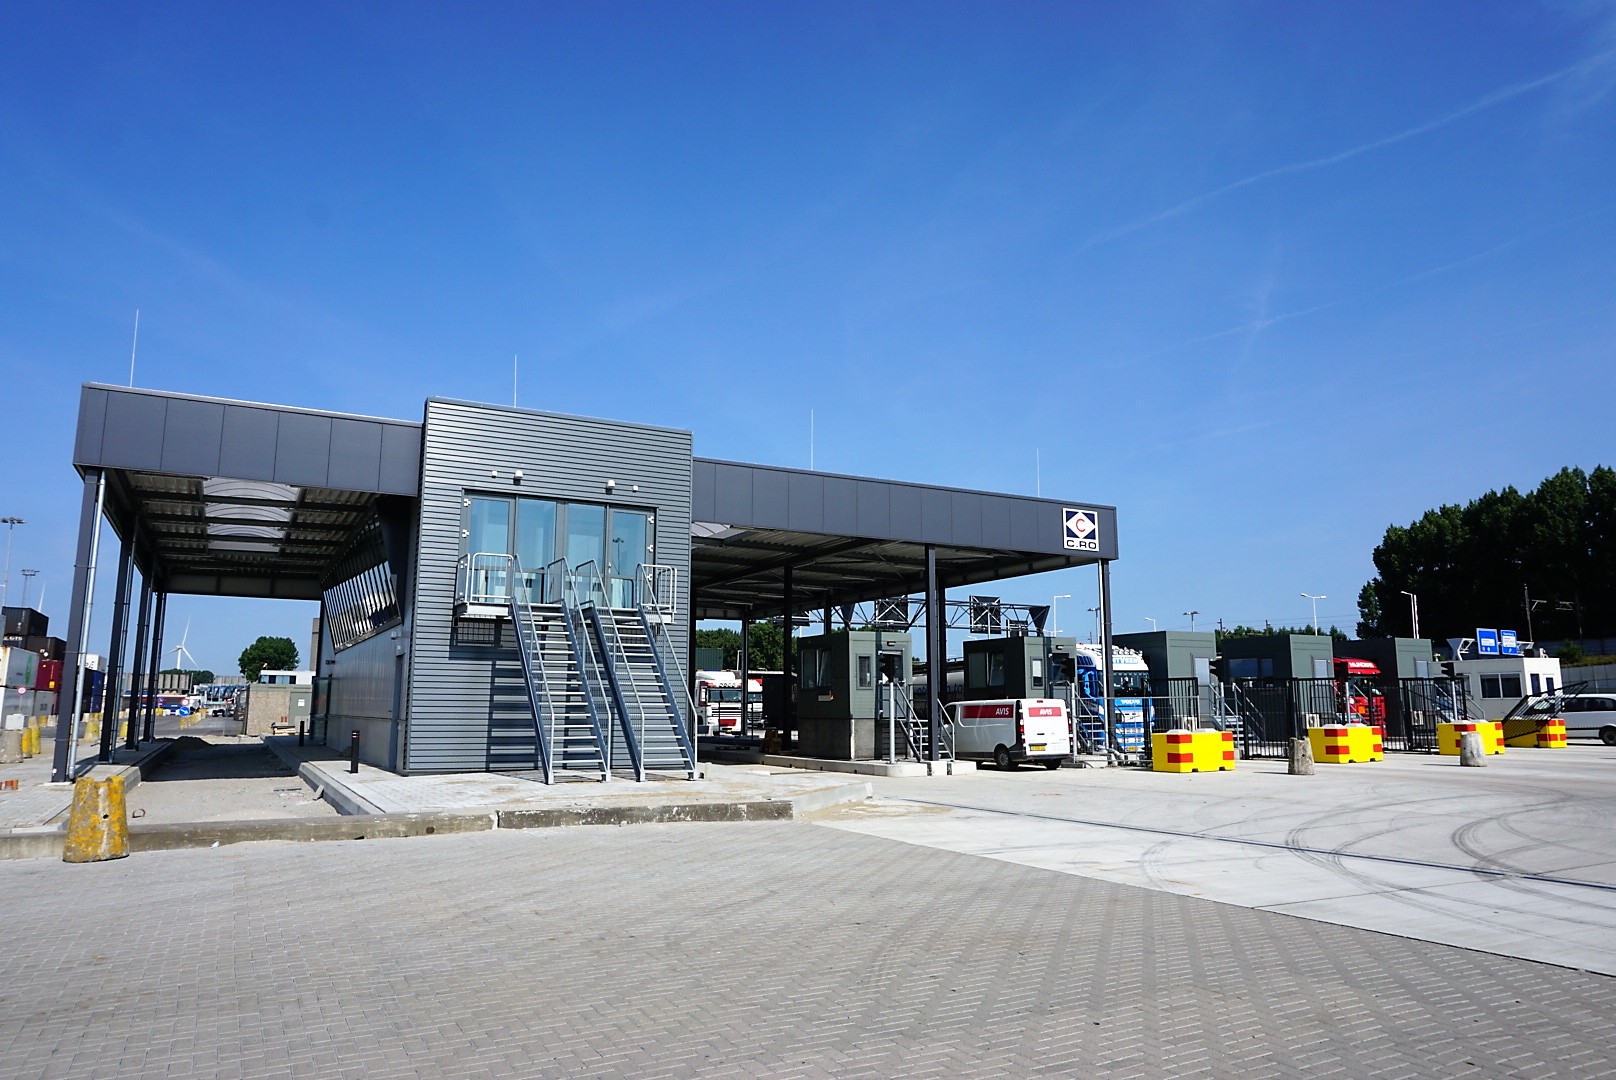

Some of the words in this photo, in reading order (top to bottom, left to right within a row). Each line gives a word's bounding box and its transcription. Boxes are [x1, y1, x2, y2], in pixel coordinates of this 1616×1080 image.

[1075, 518, 1086, 532] C
[1066, 539, 1097, 550] C.RO
[995, 707, 1009, 716] AVIS
[1039, 708, 1053, 716] AVIS
